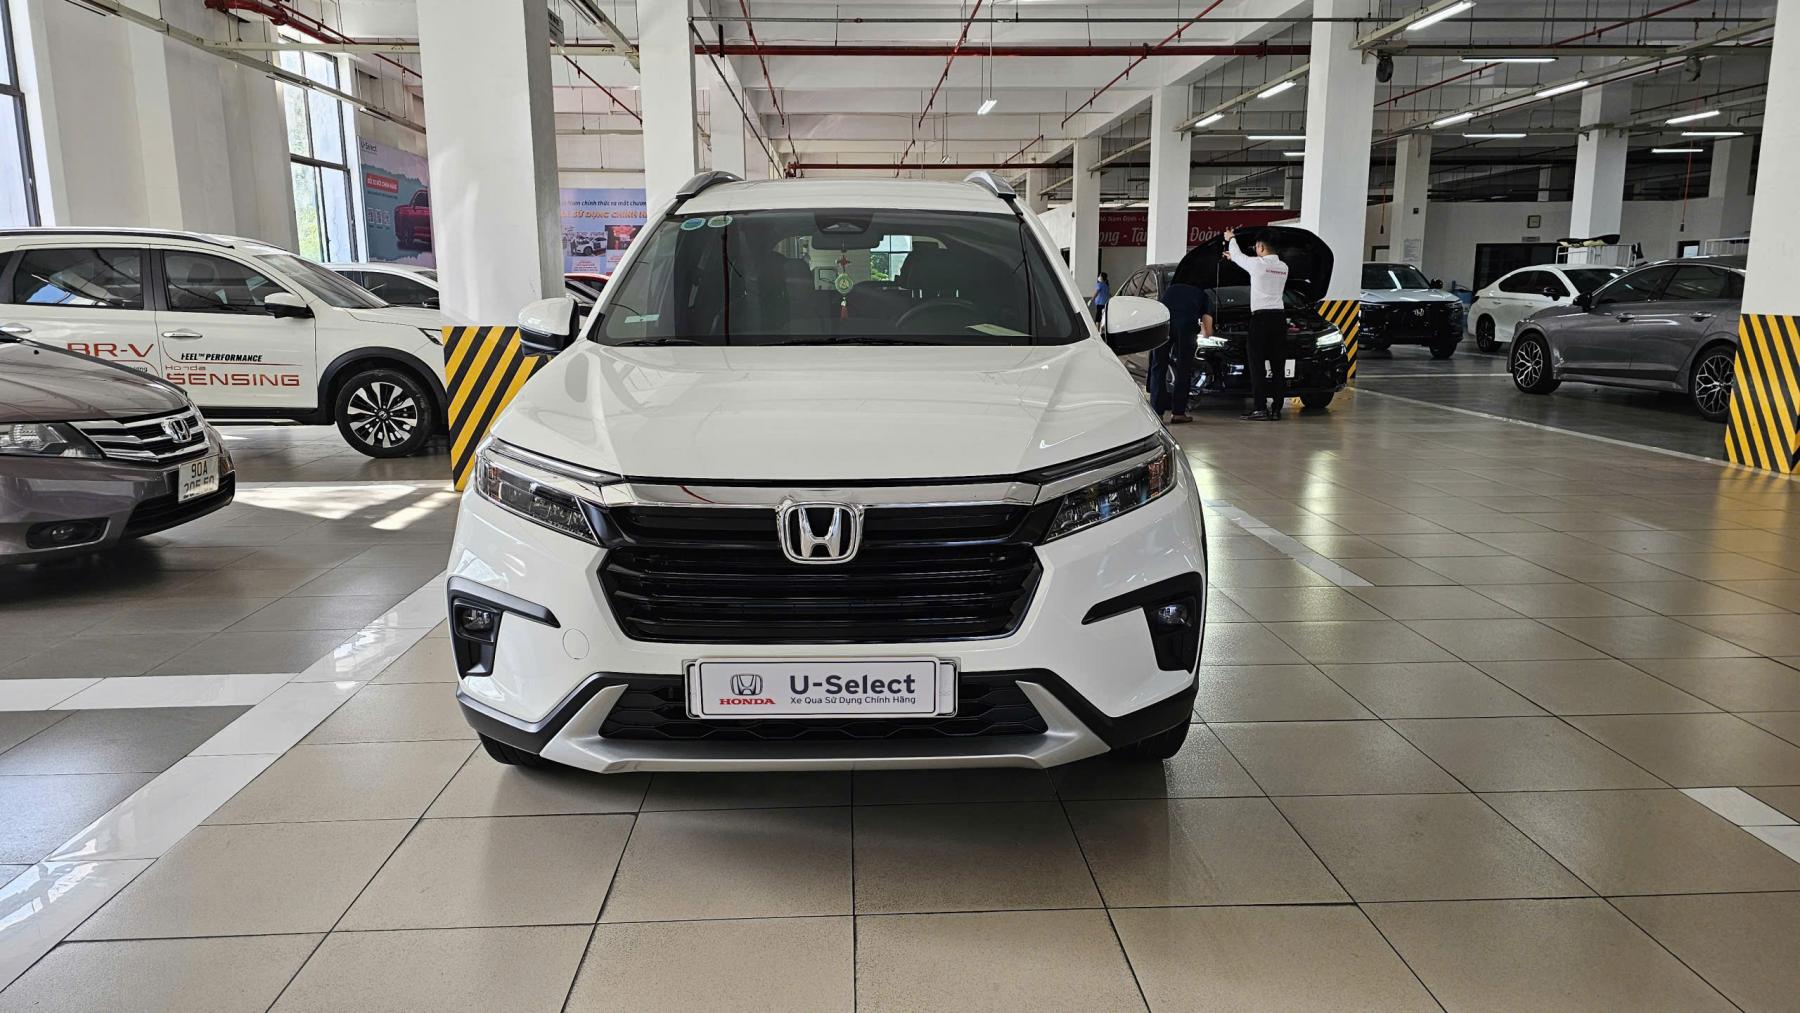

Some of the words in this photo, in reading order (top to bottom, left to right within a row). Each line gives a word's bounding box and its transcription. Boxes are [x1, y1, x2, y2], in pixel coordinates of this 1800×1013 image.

[67, 343, 154, 358] BR-V
[205, 353, 262, 362] PERFORMANCE
[166, 373, 300, 386] SENSING
[191, 460, 208, 479] 90A
[790, 674, 915, 694] U-Select
[839, 697, 862, 705] Dụng
[892, 696, 916, 704] Hãng
